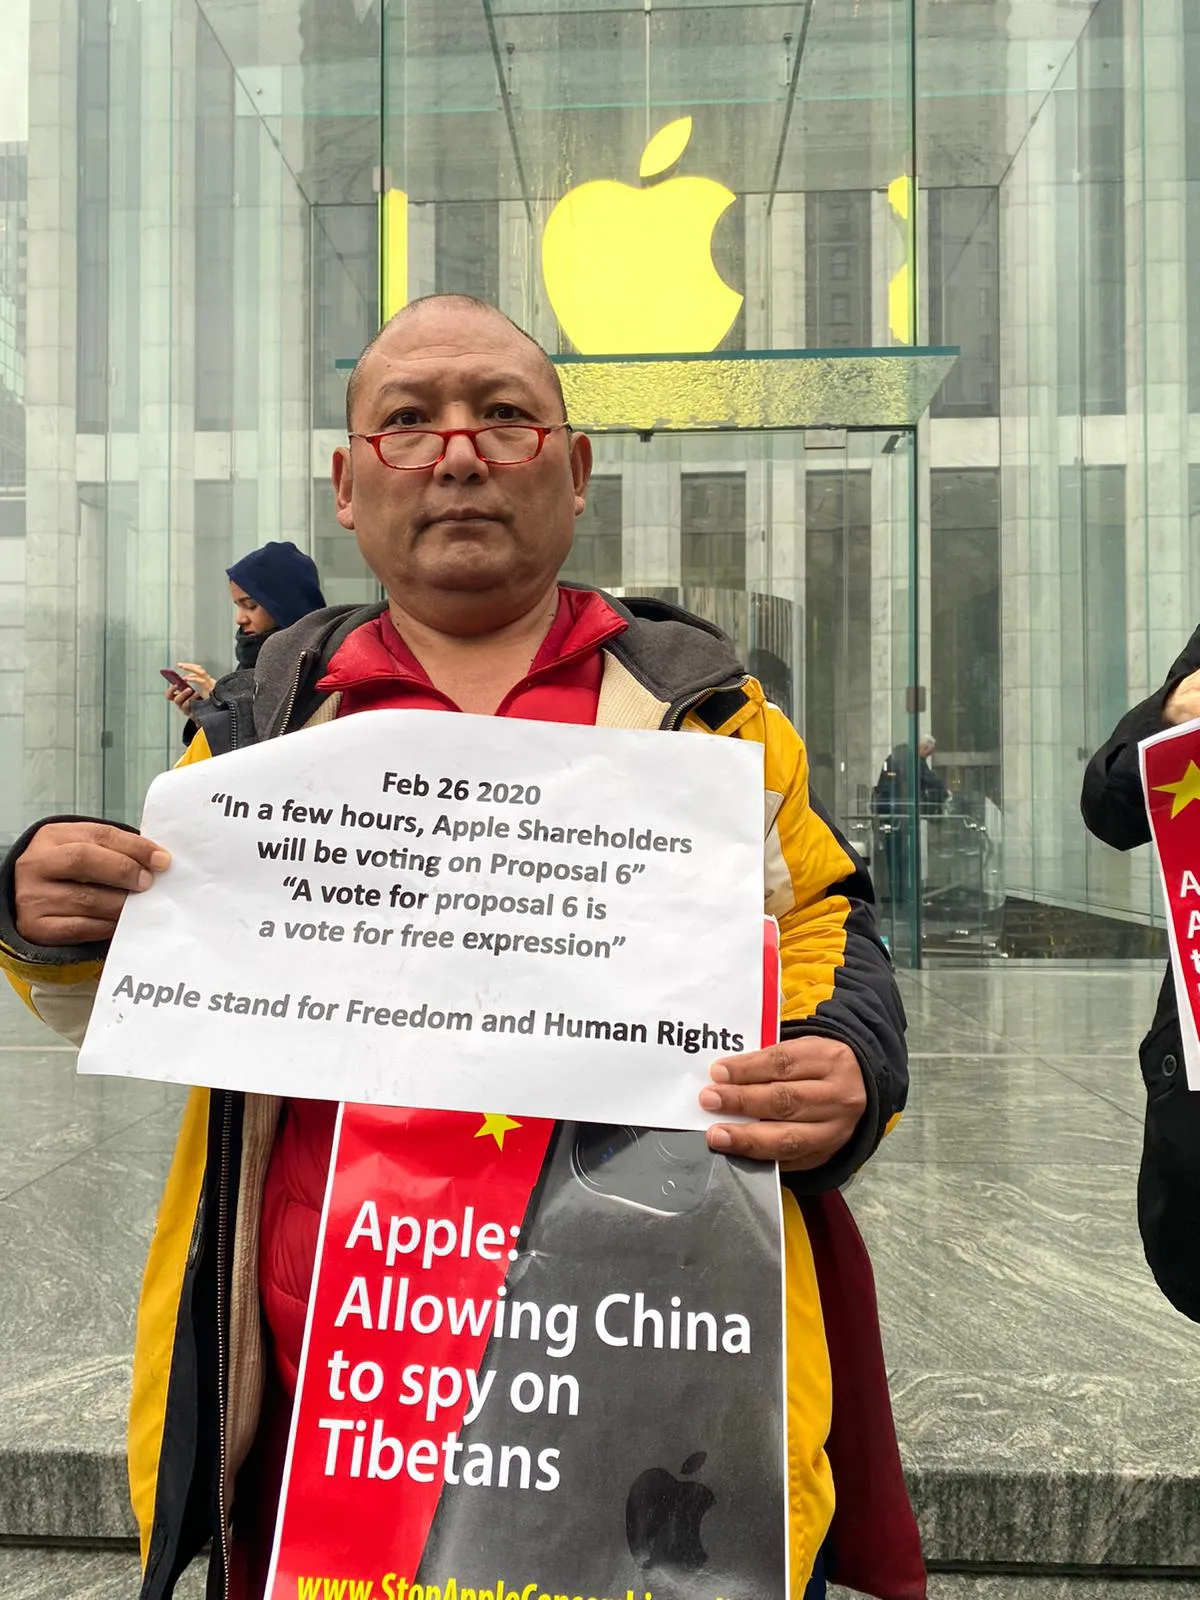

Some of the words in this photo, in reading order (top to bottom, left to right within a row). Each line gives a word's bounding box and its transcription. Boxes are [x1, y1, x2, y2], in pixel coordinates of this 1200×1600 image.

[383, 772, 430, 796] Feb
[437, 778, 469, 800] 26
[477, 782, 541, 805] 2020
[211, 793, 249, 818] “In
[258, 804, 273, 820] a
[282, 799, 333, 825] few
[340, 804, 424, 837] hours,
[432, 815, 510, 842] Apple
[517, 819, 693, 854] Shareholders
[258, 837, 306, 862] will
[314, 839, 347, 864] be
[356, 848, 441, 877] voting
[449, 856, 481, 873] on
[491, 854, 607, 884] Proposal
[616, 863, 646, 885] 6”
[282, 876, 312, 902] “A
[321, 886, 381, 907] vote
[389, 883, 429, 909] for
[435, 893, 554, 917] proposal
[562, 896, 578, 918] 6
[586, 897, 607, 920] is
[259, 921, 275, 938] a
[285, 921, 344, 942] vote
[353, 920, 393, 946] for
[401, 923, 454, 949] free
[463, 931, 627, 959] expression”
[111, 974, 200, 1008] Apple
[207, 991, 290, 1018] stand
[297, 994, 339, 1021] for
[346, 1000, 473, 1031] Freedom
[481, 1009, 535, 1035] and
[544, 1012, 648, 1044] Human
[656, 1020, 745, 1054] Rights
[345, 1200, 521, 1269] Apple:
[334, 1276, 578, 1358] Allowing
[595, 1292, 754, 1354] China
[327, 1350, 385, 1402] to
[399, 1364, 497, 1426] spy
[510, 1371, 580, 1416] on
[318, 1418, 562, 1492] Tibetans
